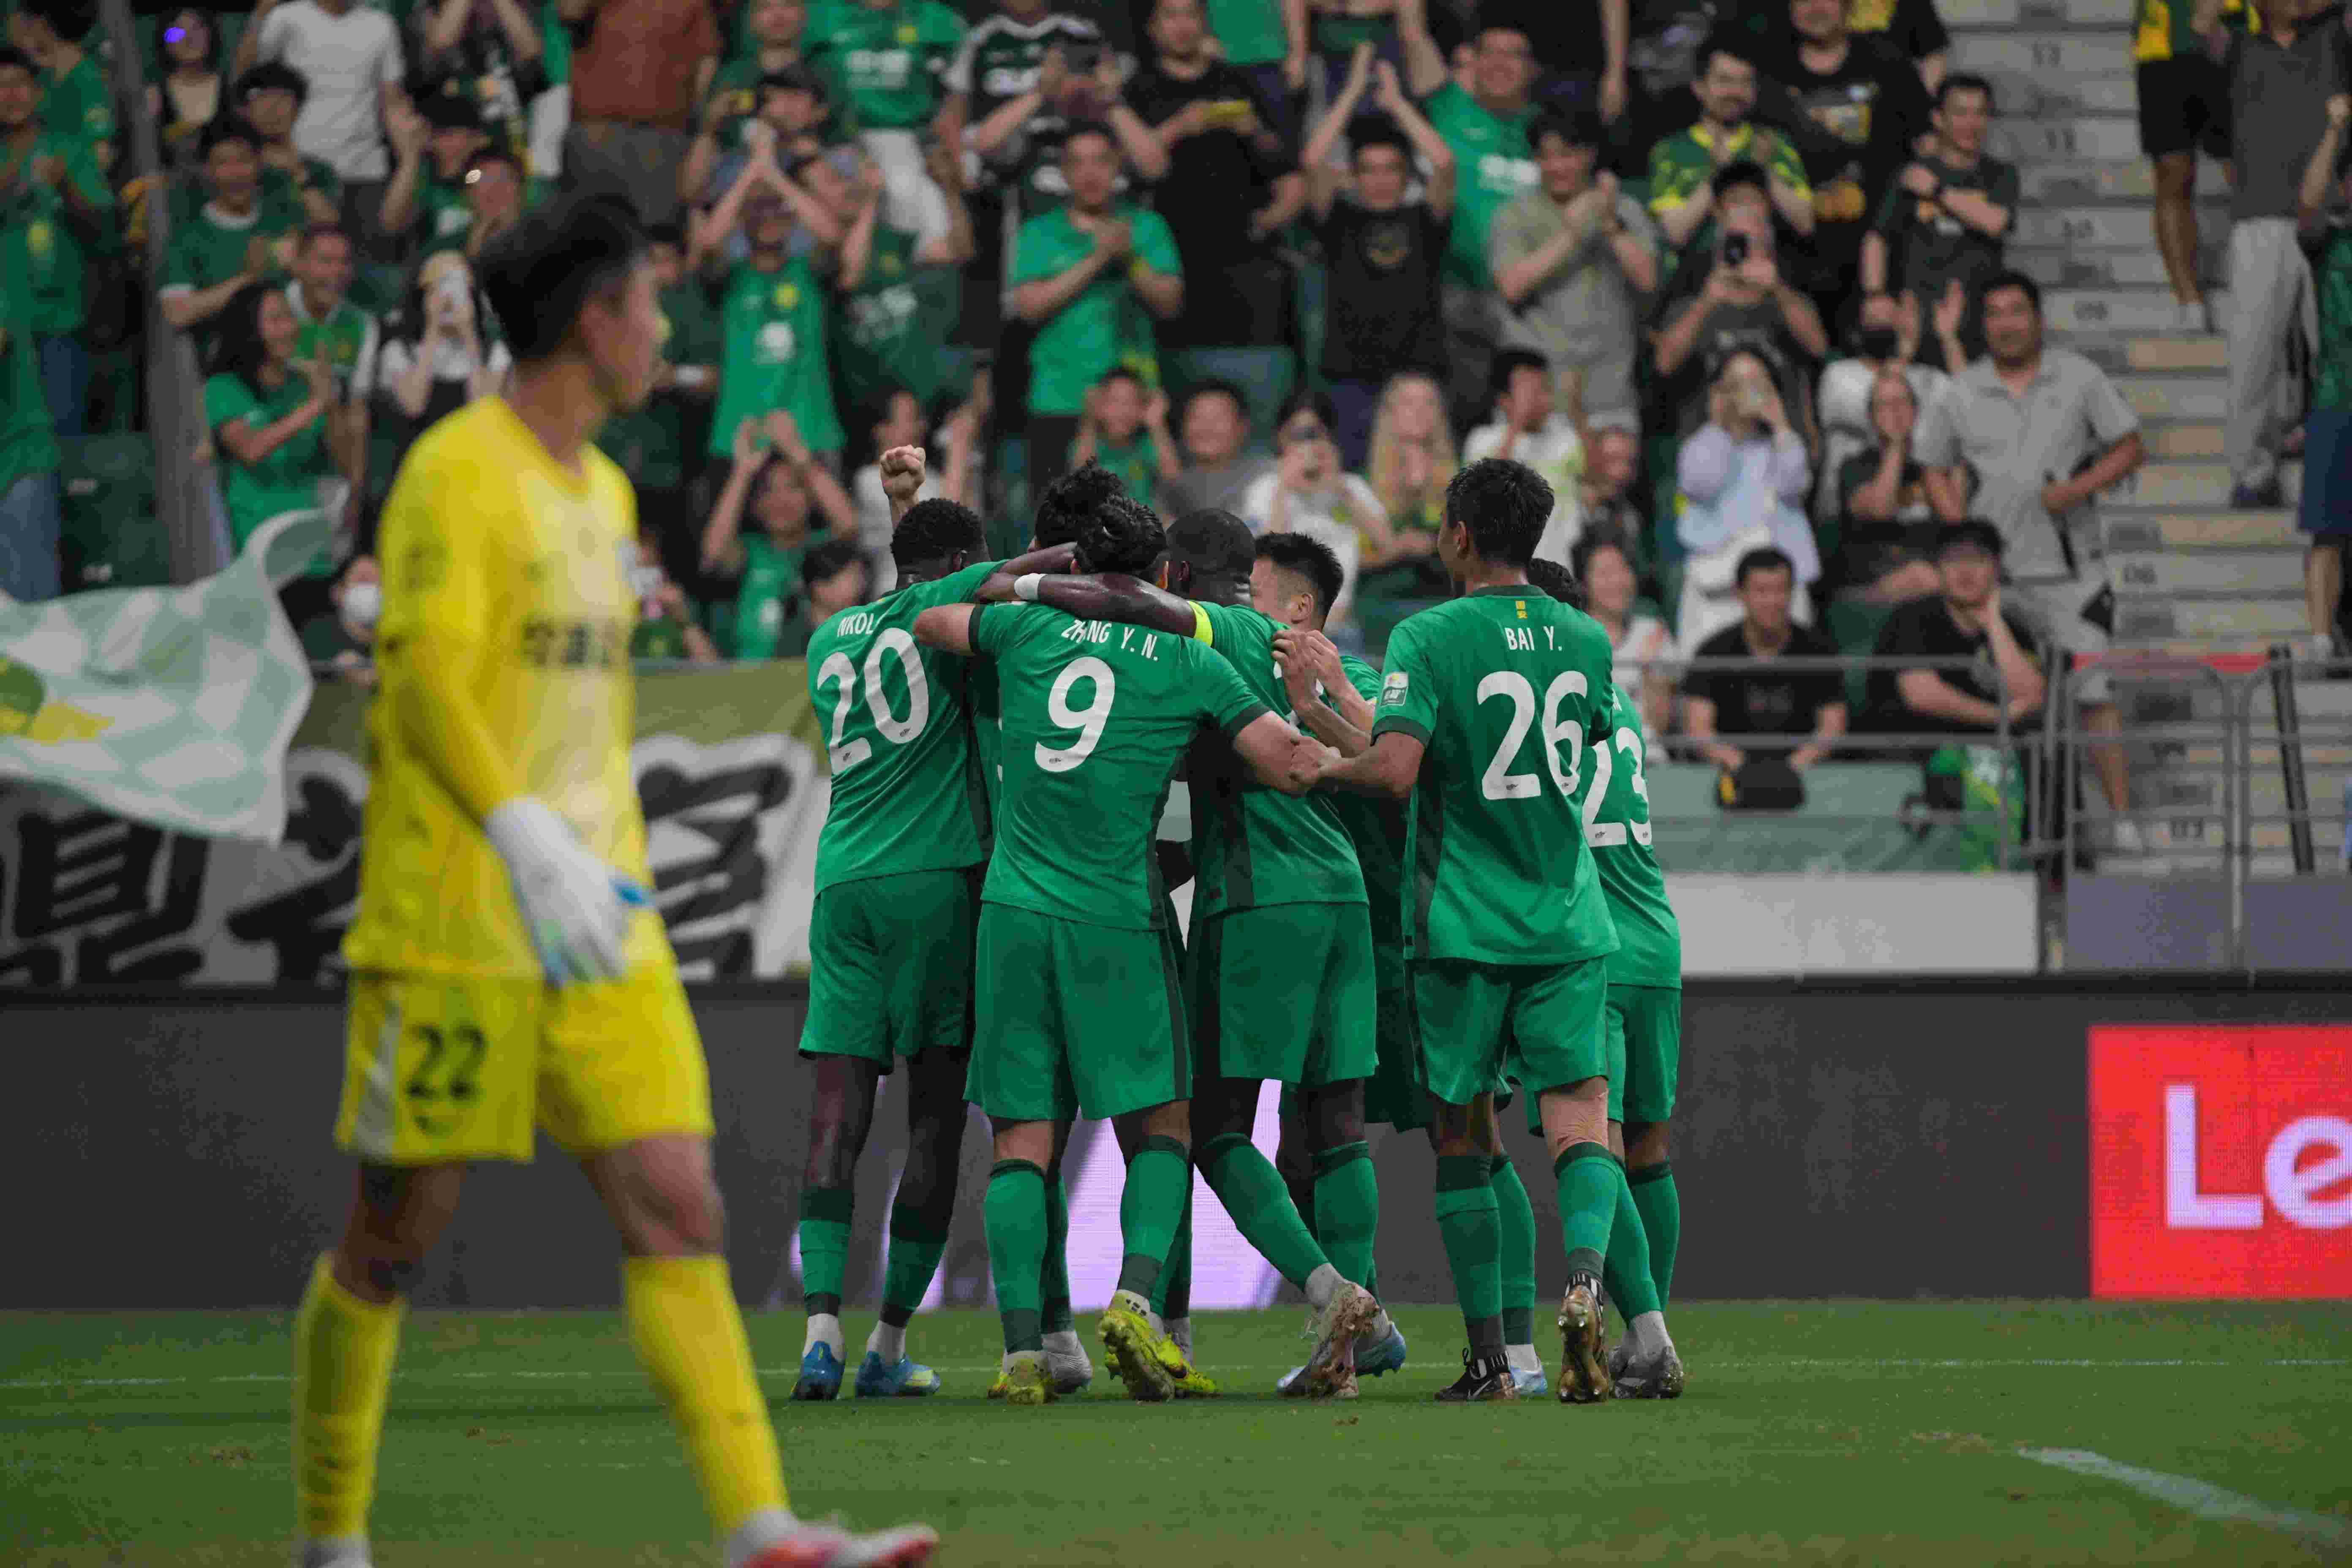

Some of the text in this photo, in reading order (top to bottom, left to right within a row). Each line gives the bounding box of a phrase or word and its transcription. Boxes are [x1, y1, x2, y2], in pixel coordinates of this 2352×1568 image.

[1061, 619, 1158, 661] ZHNG Y. N.
[1505, 626, 1562, 651] BAI Y.
[817, 628, 929, 775] 20
[1035, 656, 1115, 773] 9
[1477, 671, 1587, 800] 26
[1582, 727, 1652, 847] 23
[406, 1024, 487, 1102] 22
[2164, 1083, 2352, 1231] Le
